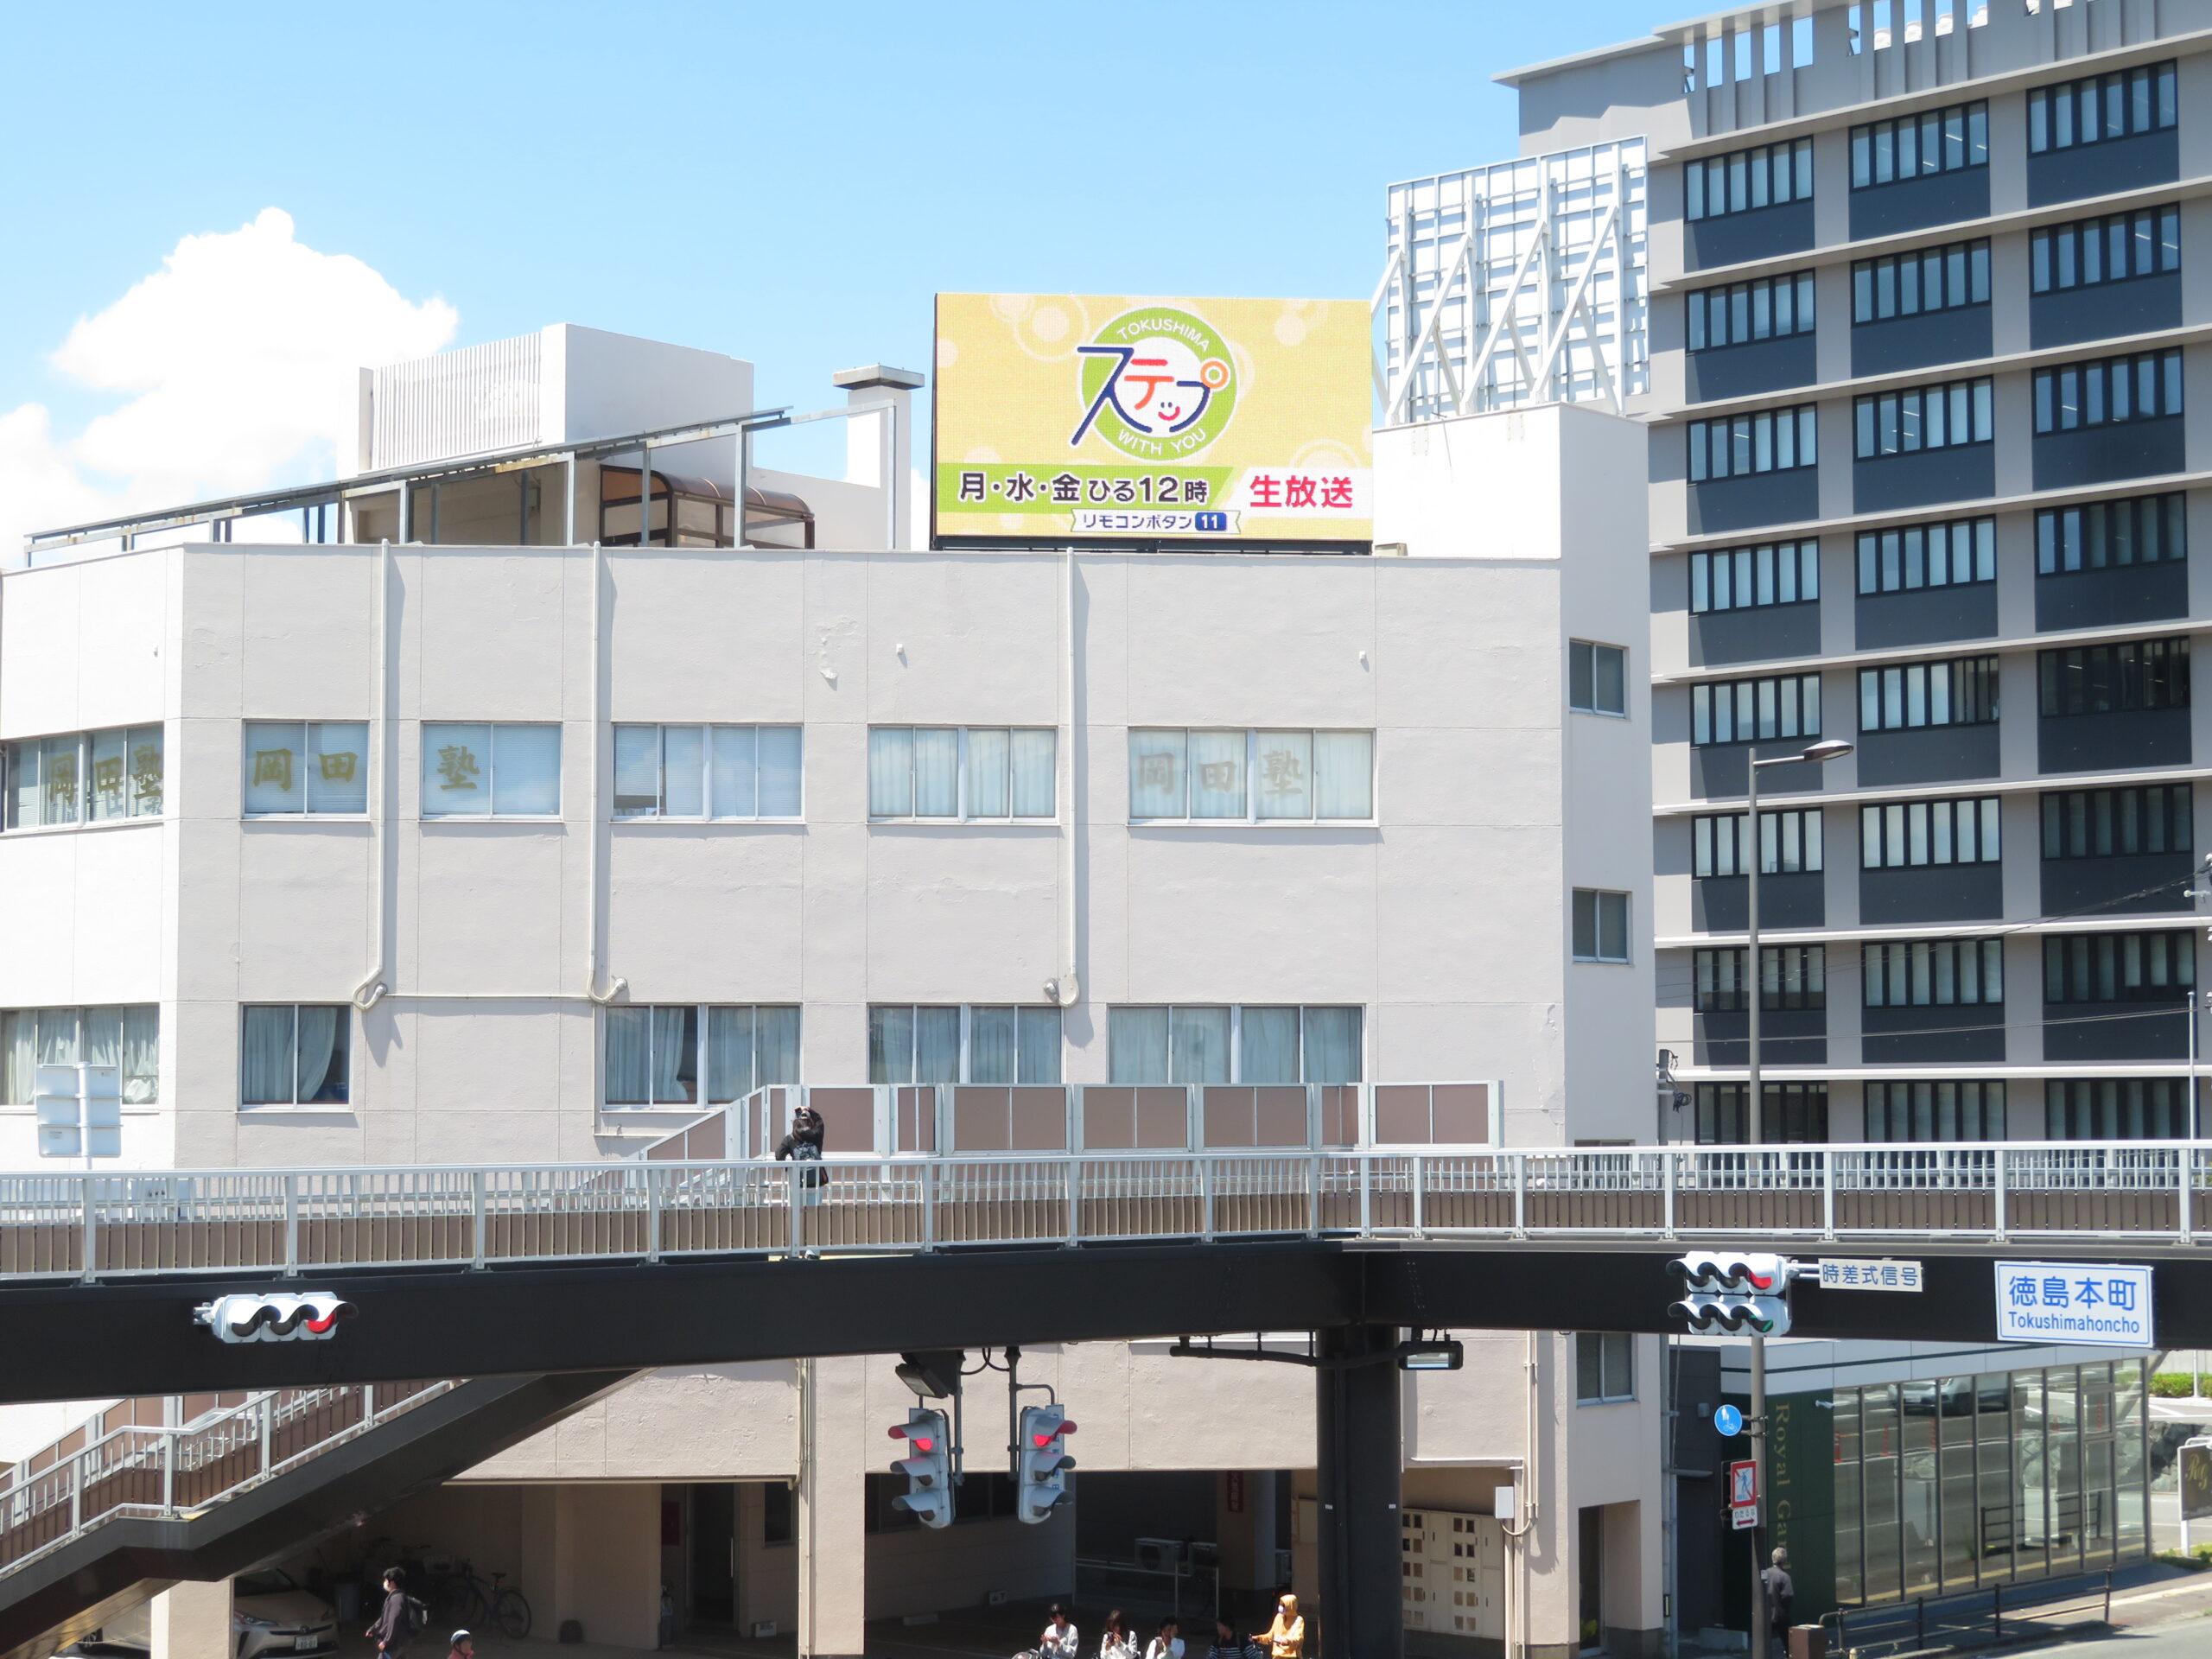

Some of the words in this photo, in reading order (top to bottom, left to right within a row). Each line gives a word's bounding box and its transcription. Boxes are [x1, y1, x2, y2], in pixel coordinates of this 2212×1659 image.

[1117, 318, 1210, 353] TOKUSHIMA
[1118, 429, 1162, 456] WITH
[1170, 427, 1206, 454] YOU
[1249, 474, 1353, 508] 生放送
[1084, 513, 1192, 531] リモコンボタン
[1200, 514, 1219, 530] 11
[1822, 1264, 1918, 1287] 時差式信号
[2009, 1275, 2138, 1311] 徳島本町
[2008, 1311, 2139, 1333] Tokushimahoncho
[1774, 1403, 1790, 1486] Royal
